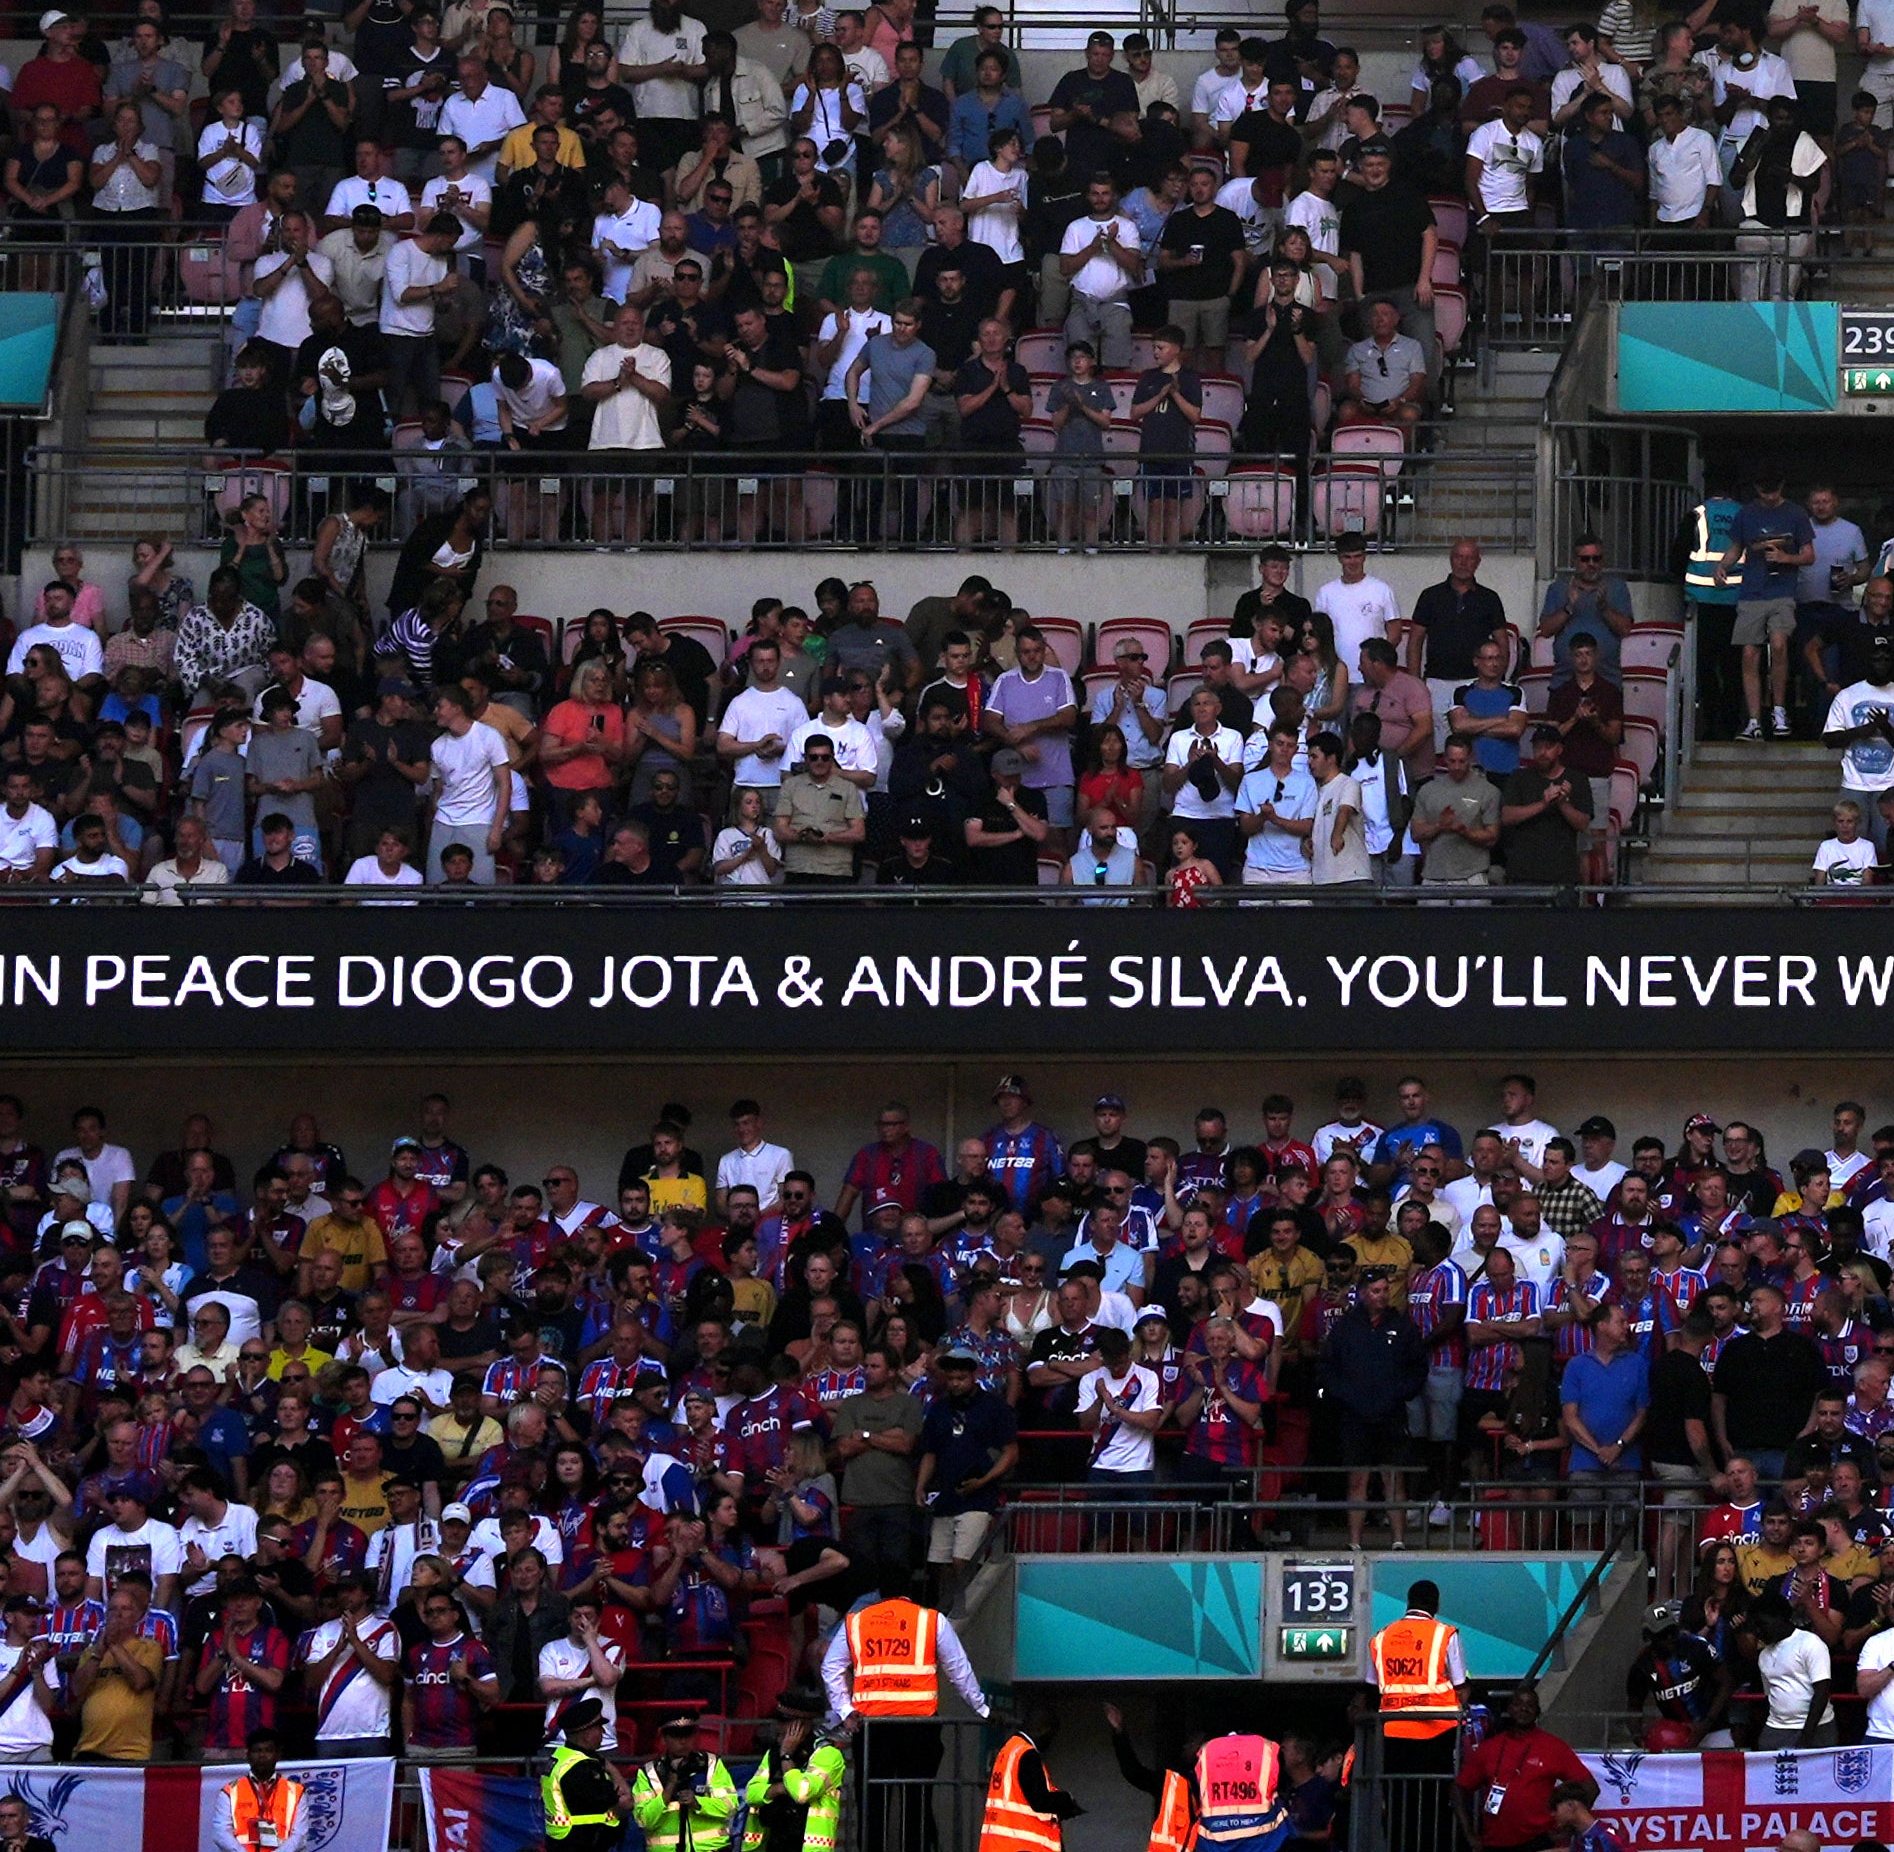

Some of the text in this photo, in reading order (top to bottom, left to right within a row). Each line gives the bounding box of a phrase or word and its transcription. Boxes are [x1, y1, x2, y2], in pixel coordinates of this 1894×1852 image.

[86, 954, 315, 1008] PEACE
[339, 954, 573, 1009] DIOGO
[590, 955, 759, 1008] JOTA
[778, 955, 824, 1008] &
[841, 940, 1087, 1007] ANDRÉ
[1109, 955, 1307, 1009] SILVA.
[1327, 955, 1568, 1008] YOU'LL
[1586, 955, 1818, 1007] NEVER
[986, 1157, 1035, 1169] NET88
[740, 1416, 782, 1438] cinch
[1287, 1581, 1350, 1612] 133
[865, 1637, 911, 1657] S1729
[1211, 1780, 1257, 1801] RT496
